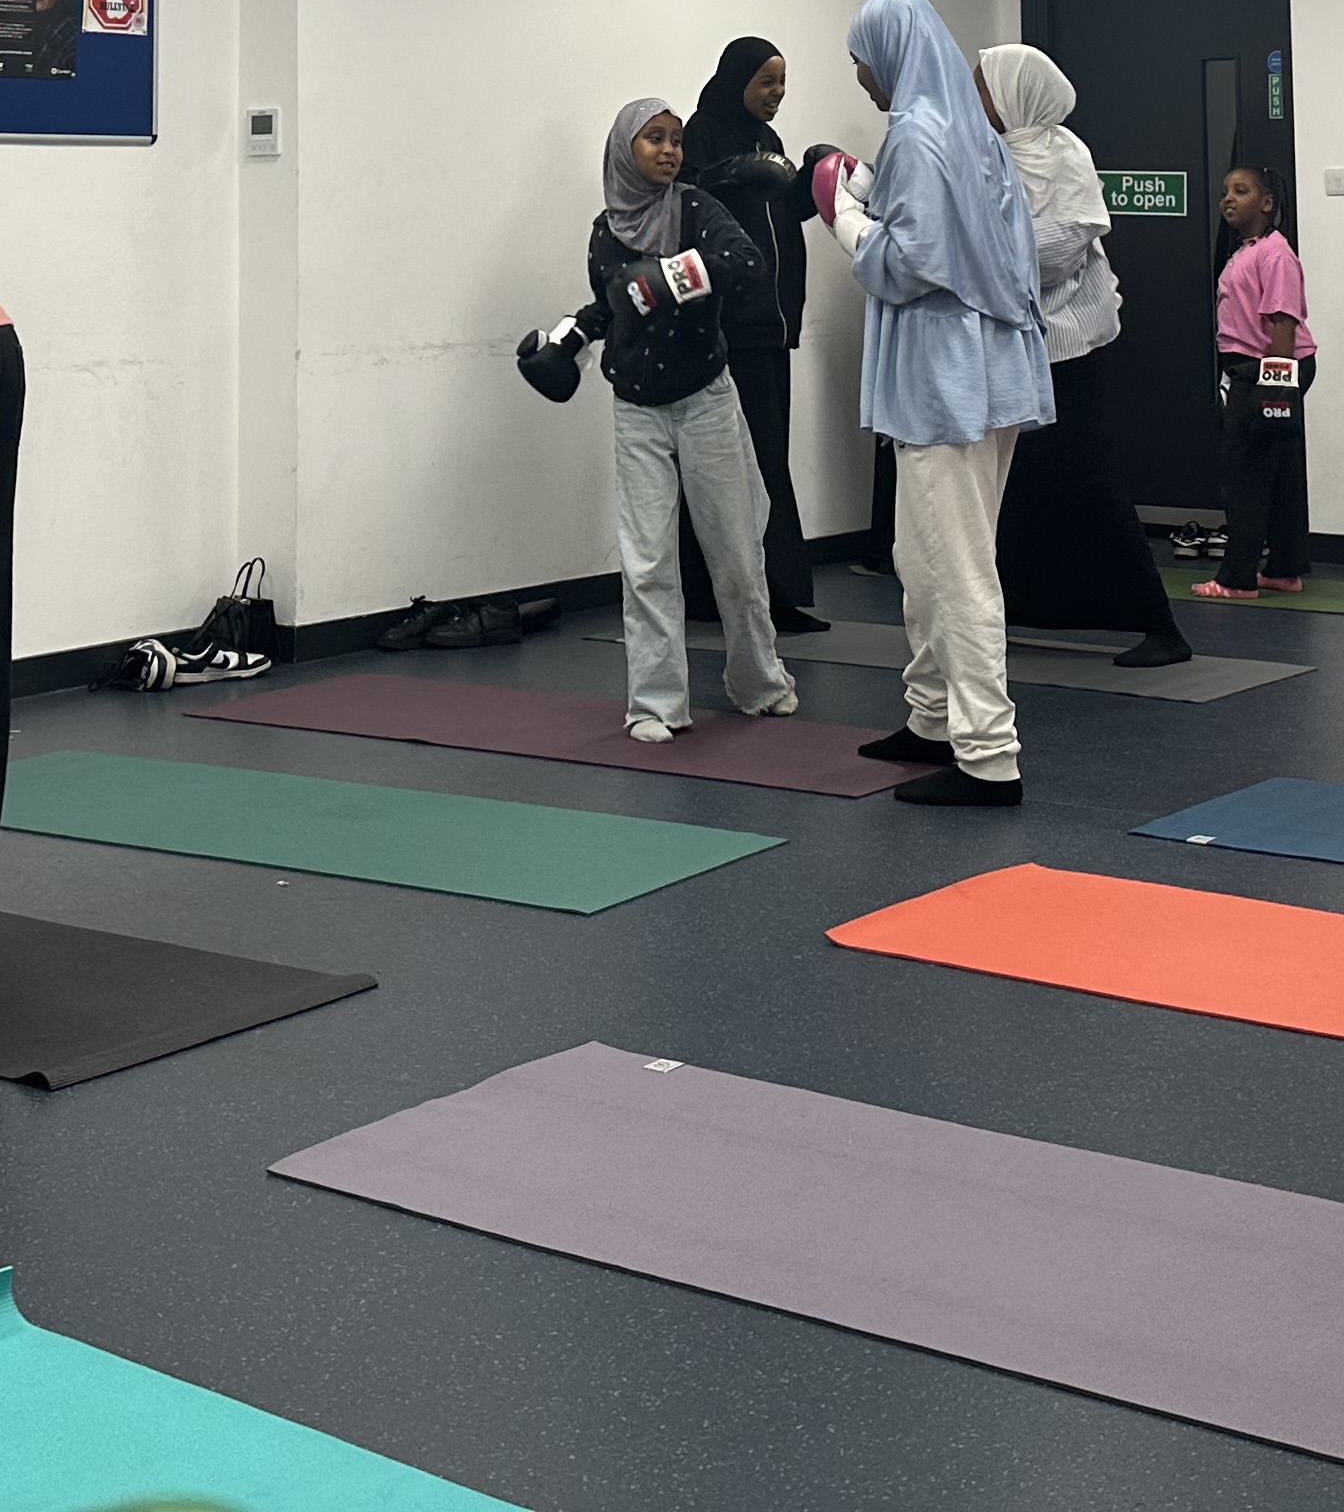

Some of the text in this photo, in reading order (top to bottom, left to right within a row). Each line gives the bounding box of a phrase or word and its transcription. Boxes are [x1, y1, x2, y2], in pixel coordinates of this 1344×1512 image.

[1272, 77, 1280, 116] PUSH
[1122, 176, 1165, 192] Push
[1111, 191, 1176, 210] to open
[667, 260, 693, 295] PRO
[1262, 370, 1292, 382] PRO
[1263, 407, 1290, 418] PRO
